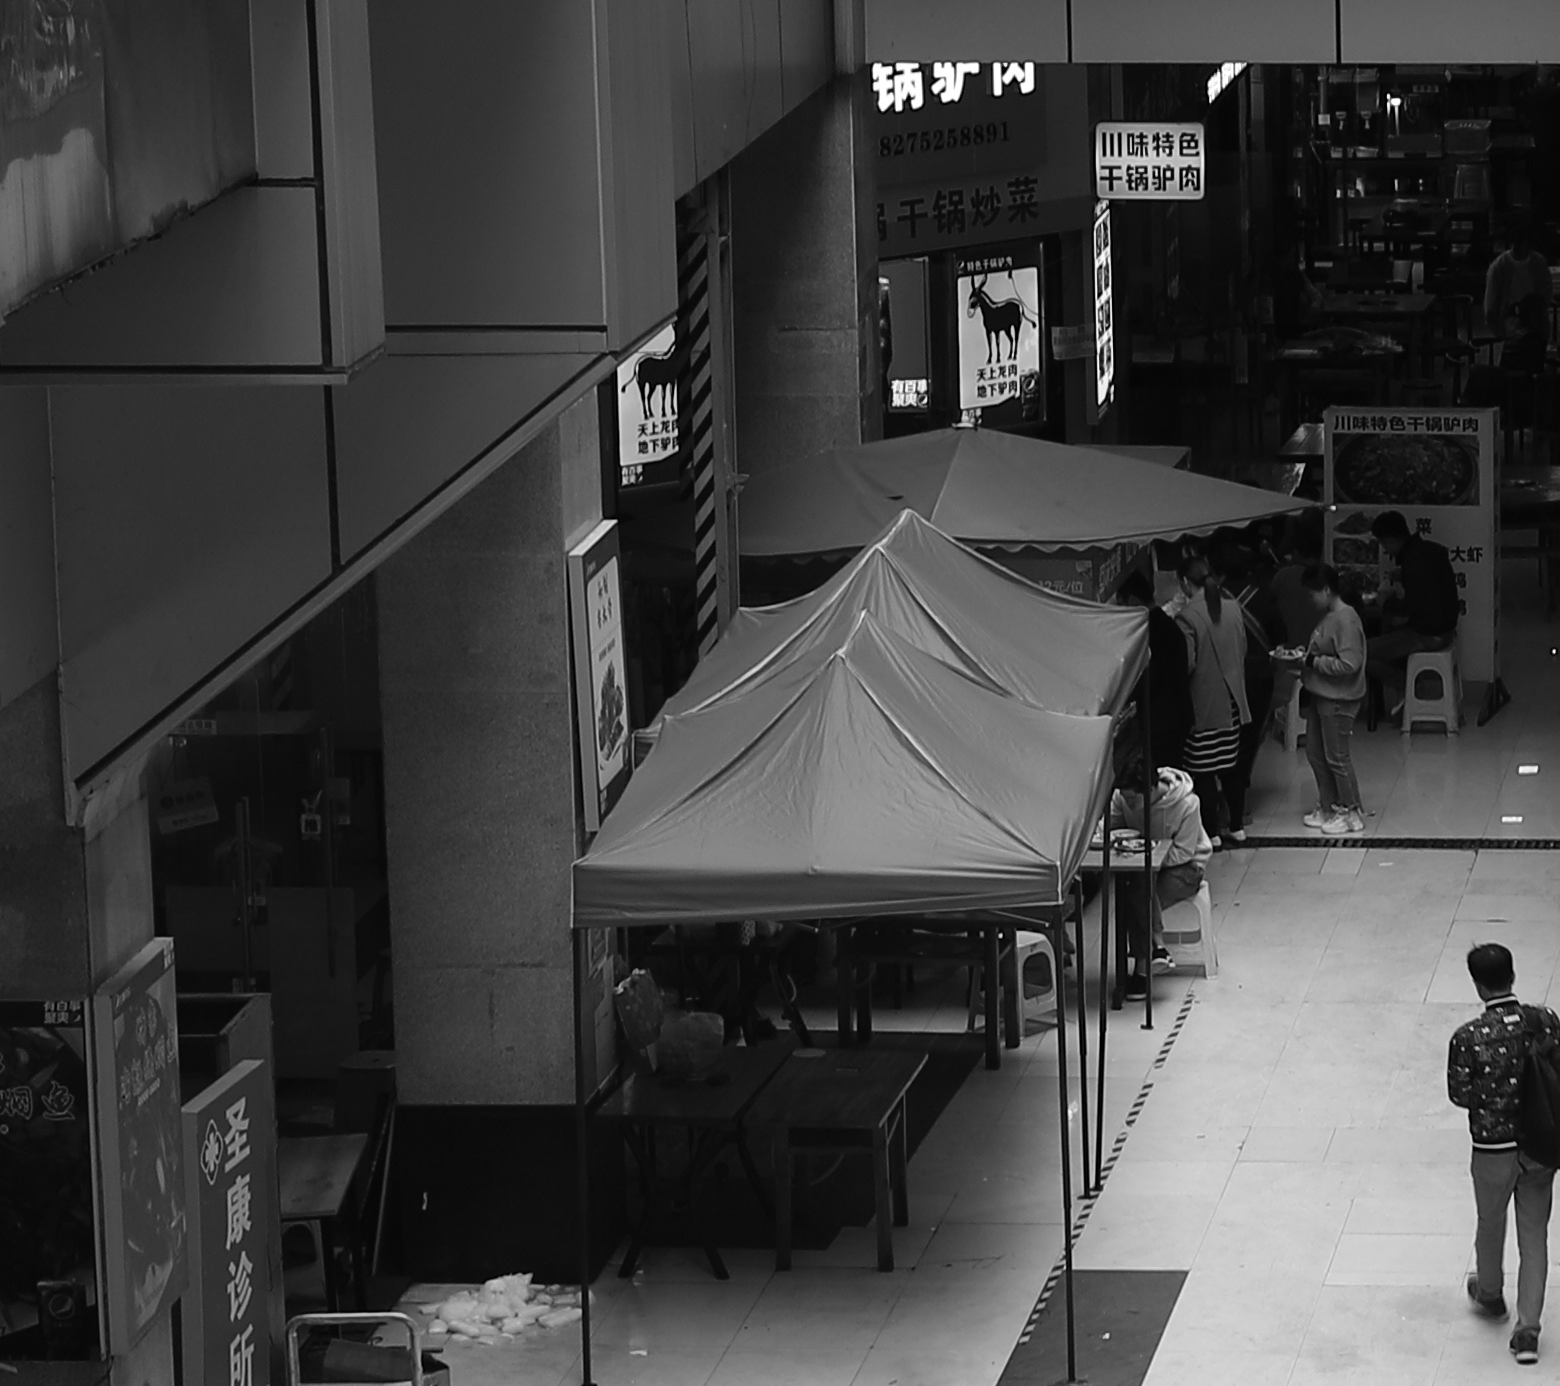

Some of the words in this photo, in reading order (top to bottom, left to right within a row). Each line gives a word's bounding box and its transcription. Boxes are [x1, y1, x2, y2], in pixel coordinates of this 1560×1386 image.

[879, 121, 1009, 157] 8275258891
[1101, 131, 1200, 159] 川味特色
[1099, 165, 1201, 192] 干锅驴肉
[976, 364, 1018, 383] 天上龙肉
[976, 379, 1018, 399] 地下驴肉
[1334, 416, 1478, 432] 川味特色干锅驴肉
[1450, 546, 1483, 563] 大虾
